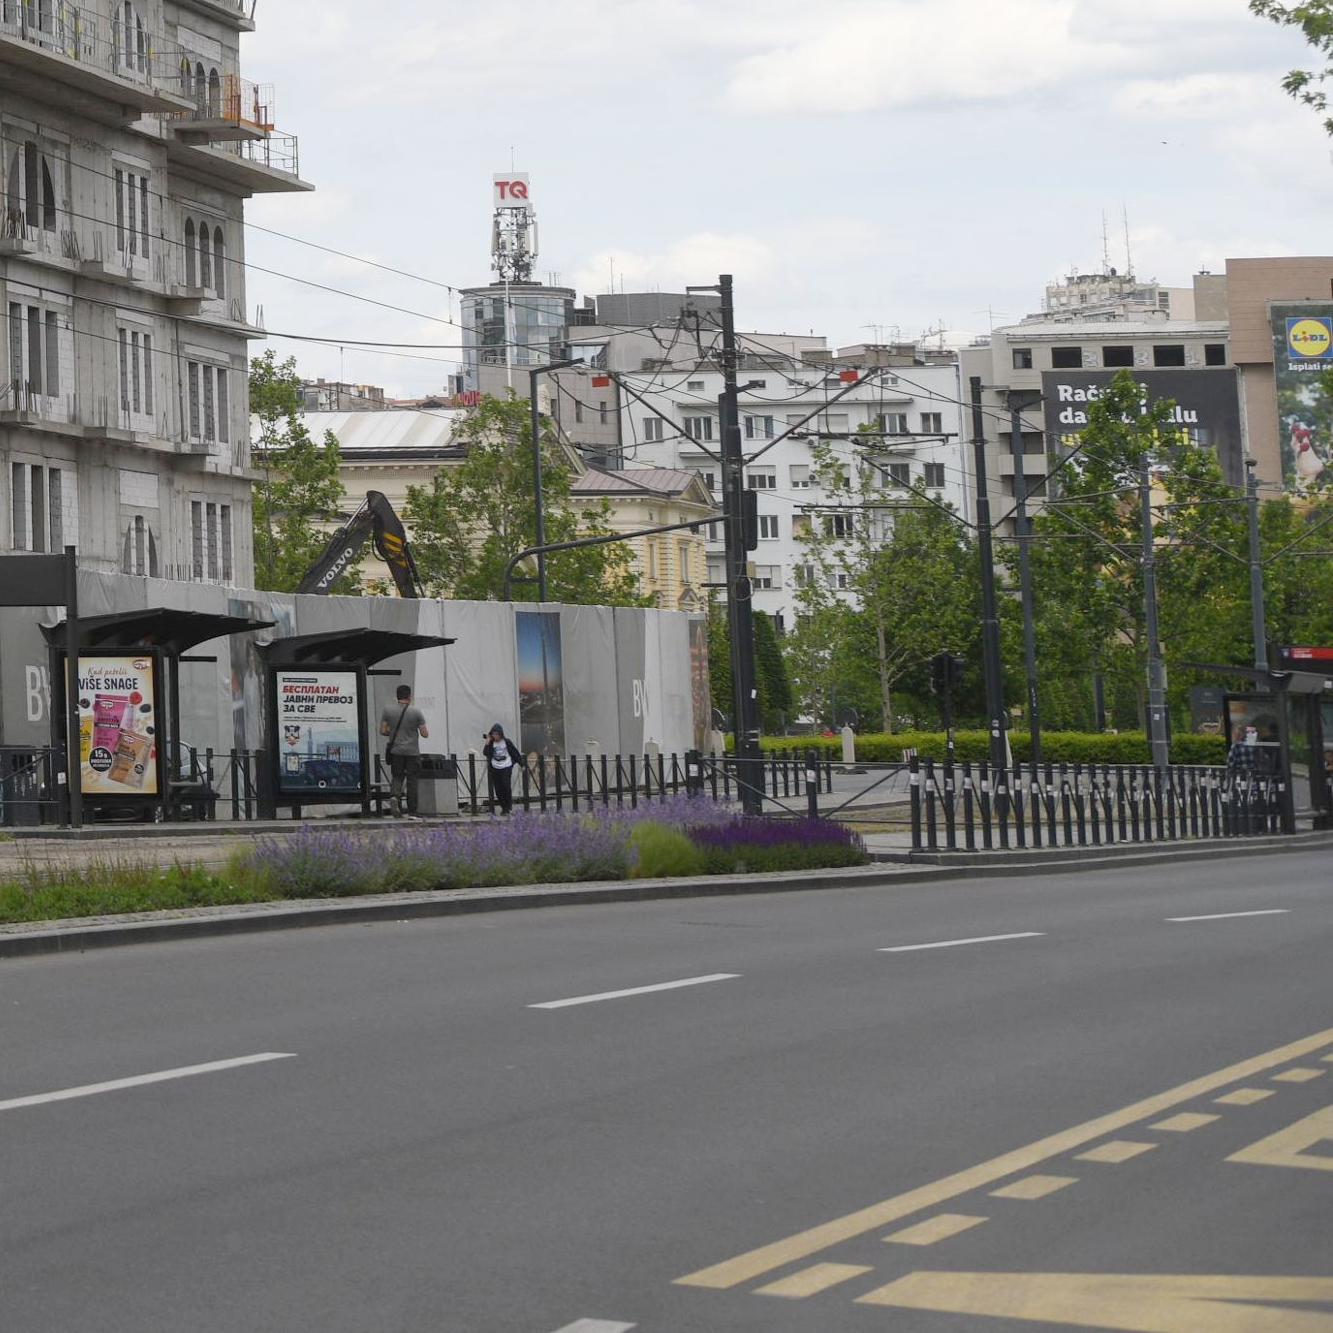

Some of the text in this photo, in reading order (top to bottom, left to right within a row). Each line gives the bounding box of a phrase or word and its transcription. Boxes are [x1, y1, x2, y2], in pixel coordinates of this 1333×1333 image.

[1288, 362, 1321, 373] Isplati
[317, 548, 353, 588] VOLVO
[104, 678, 139, 690] SNAGE
[282, 685, 340, 694] БЕСПЛАТАН
[283, 695, 353, 705] ЈАВНИ ПРЕВОЗ
[283, 705, 316, 713] ЗА СВЕ
